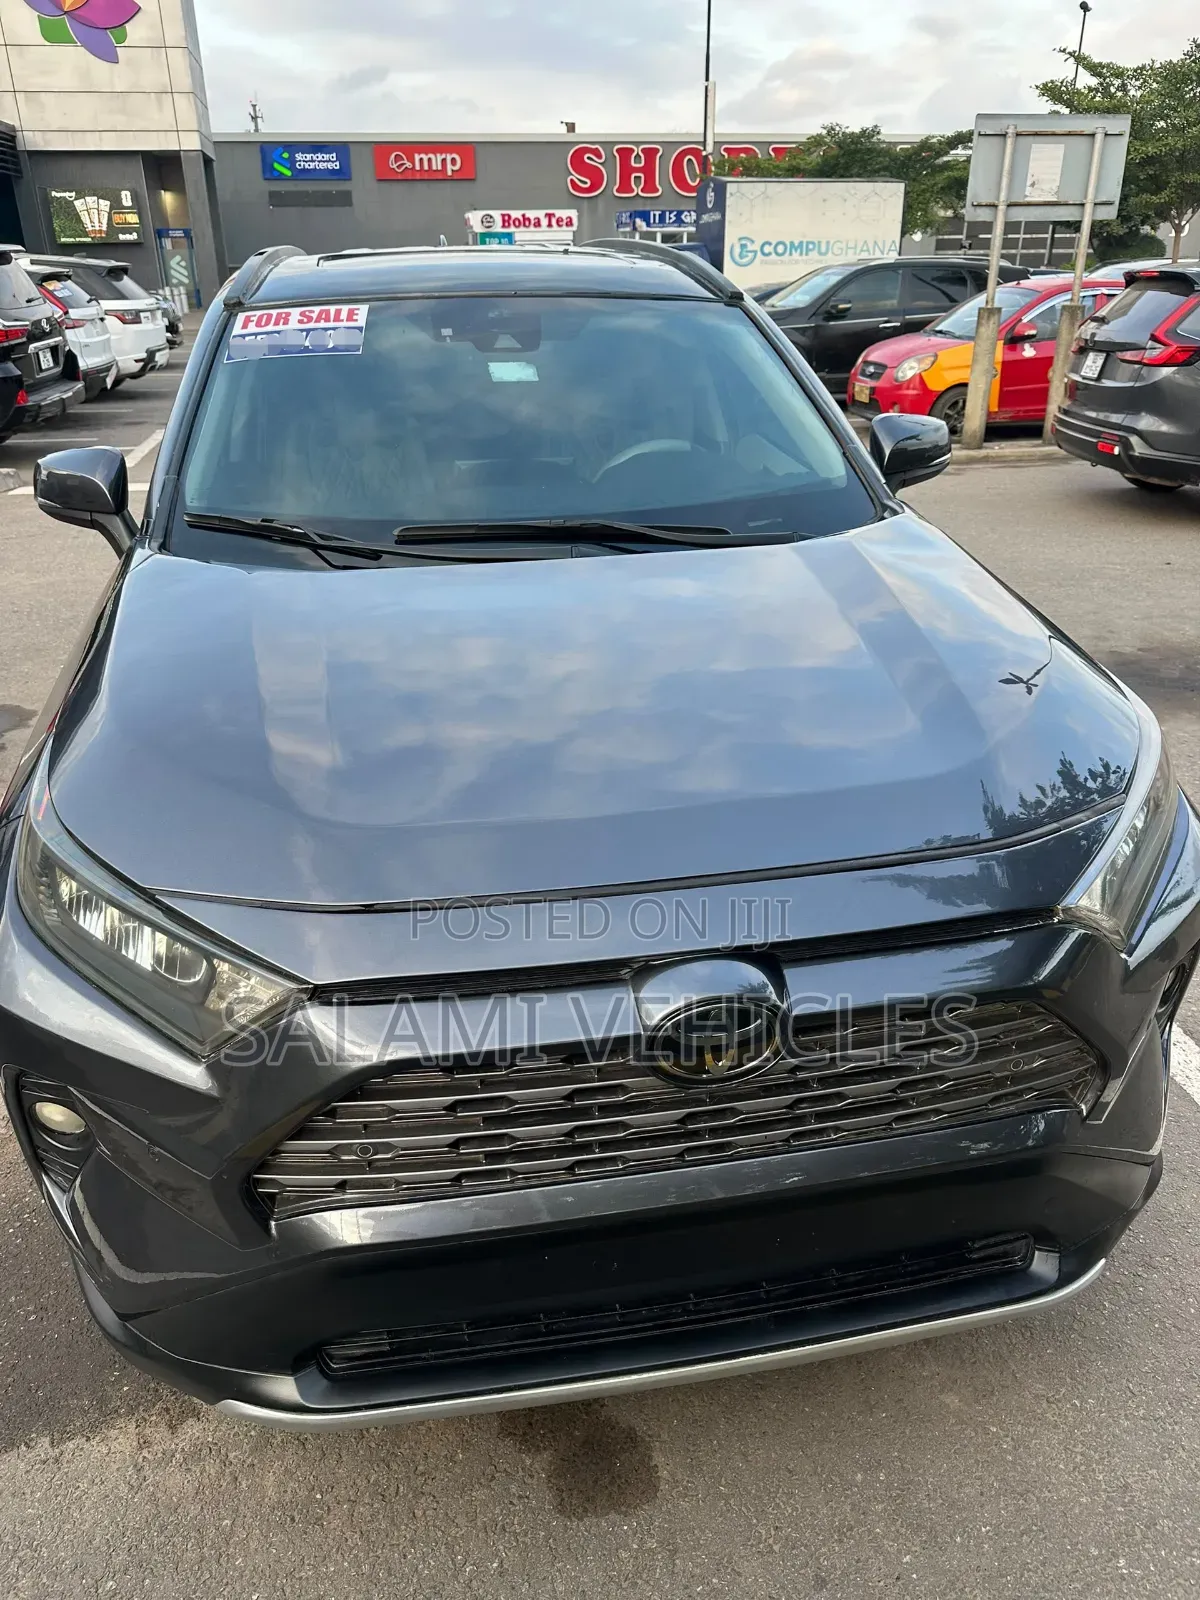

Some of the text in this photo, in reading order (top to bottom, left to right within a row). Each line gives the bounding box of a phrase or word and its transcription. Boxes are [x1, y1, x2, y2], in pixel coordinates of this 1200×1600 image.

[295, 152, 337, 161] standard
[414, 152, 462, 176] mrp
[296, 160, 340, 170] chartered
[500, 213, 542, 228] Boba
[544, 213, 574, 228] Tea
[649, 211, 662, 224] IT
[665, 211, 678, 224] IS
[759, 239, 899, 257] COMPUGHANA
[240, 308, 360, 330] FOR SALE
